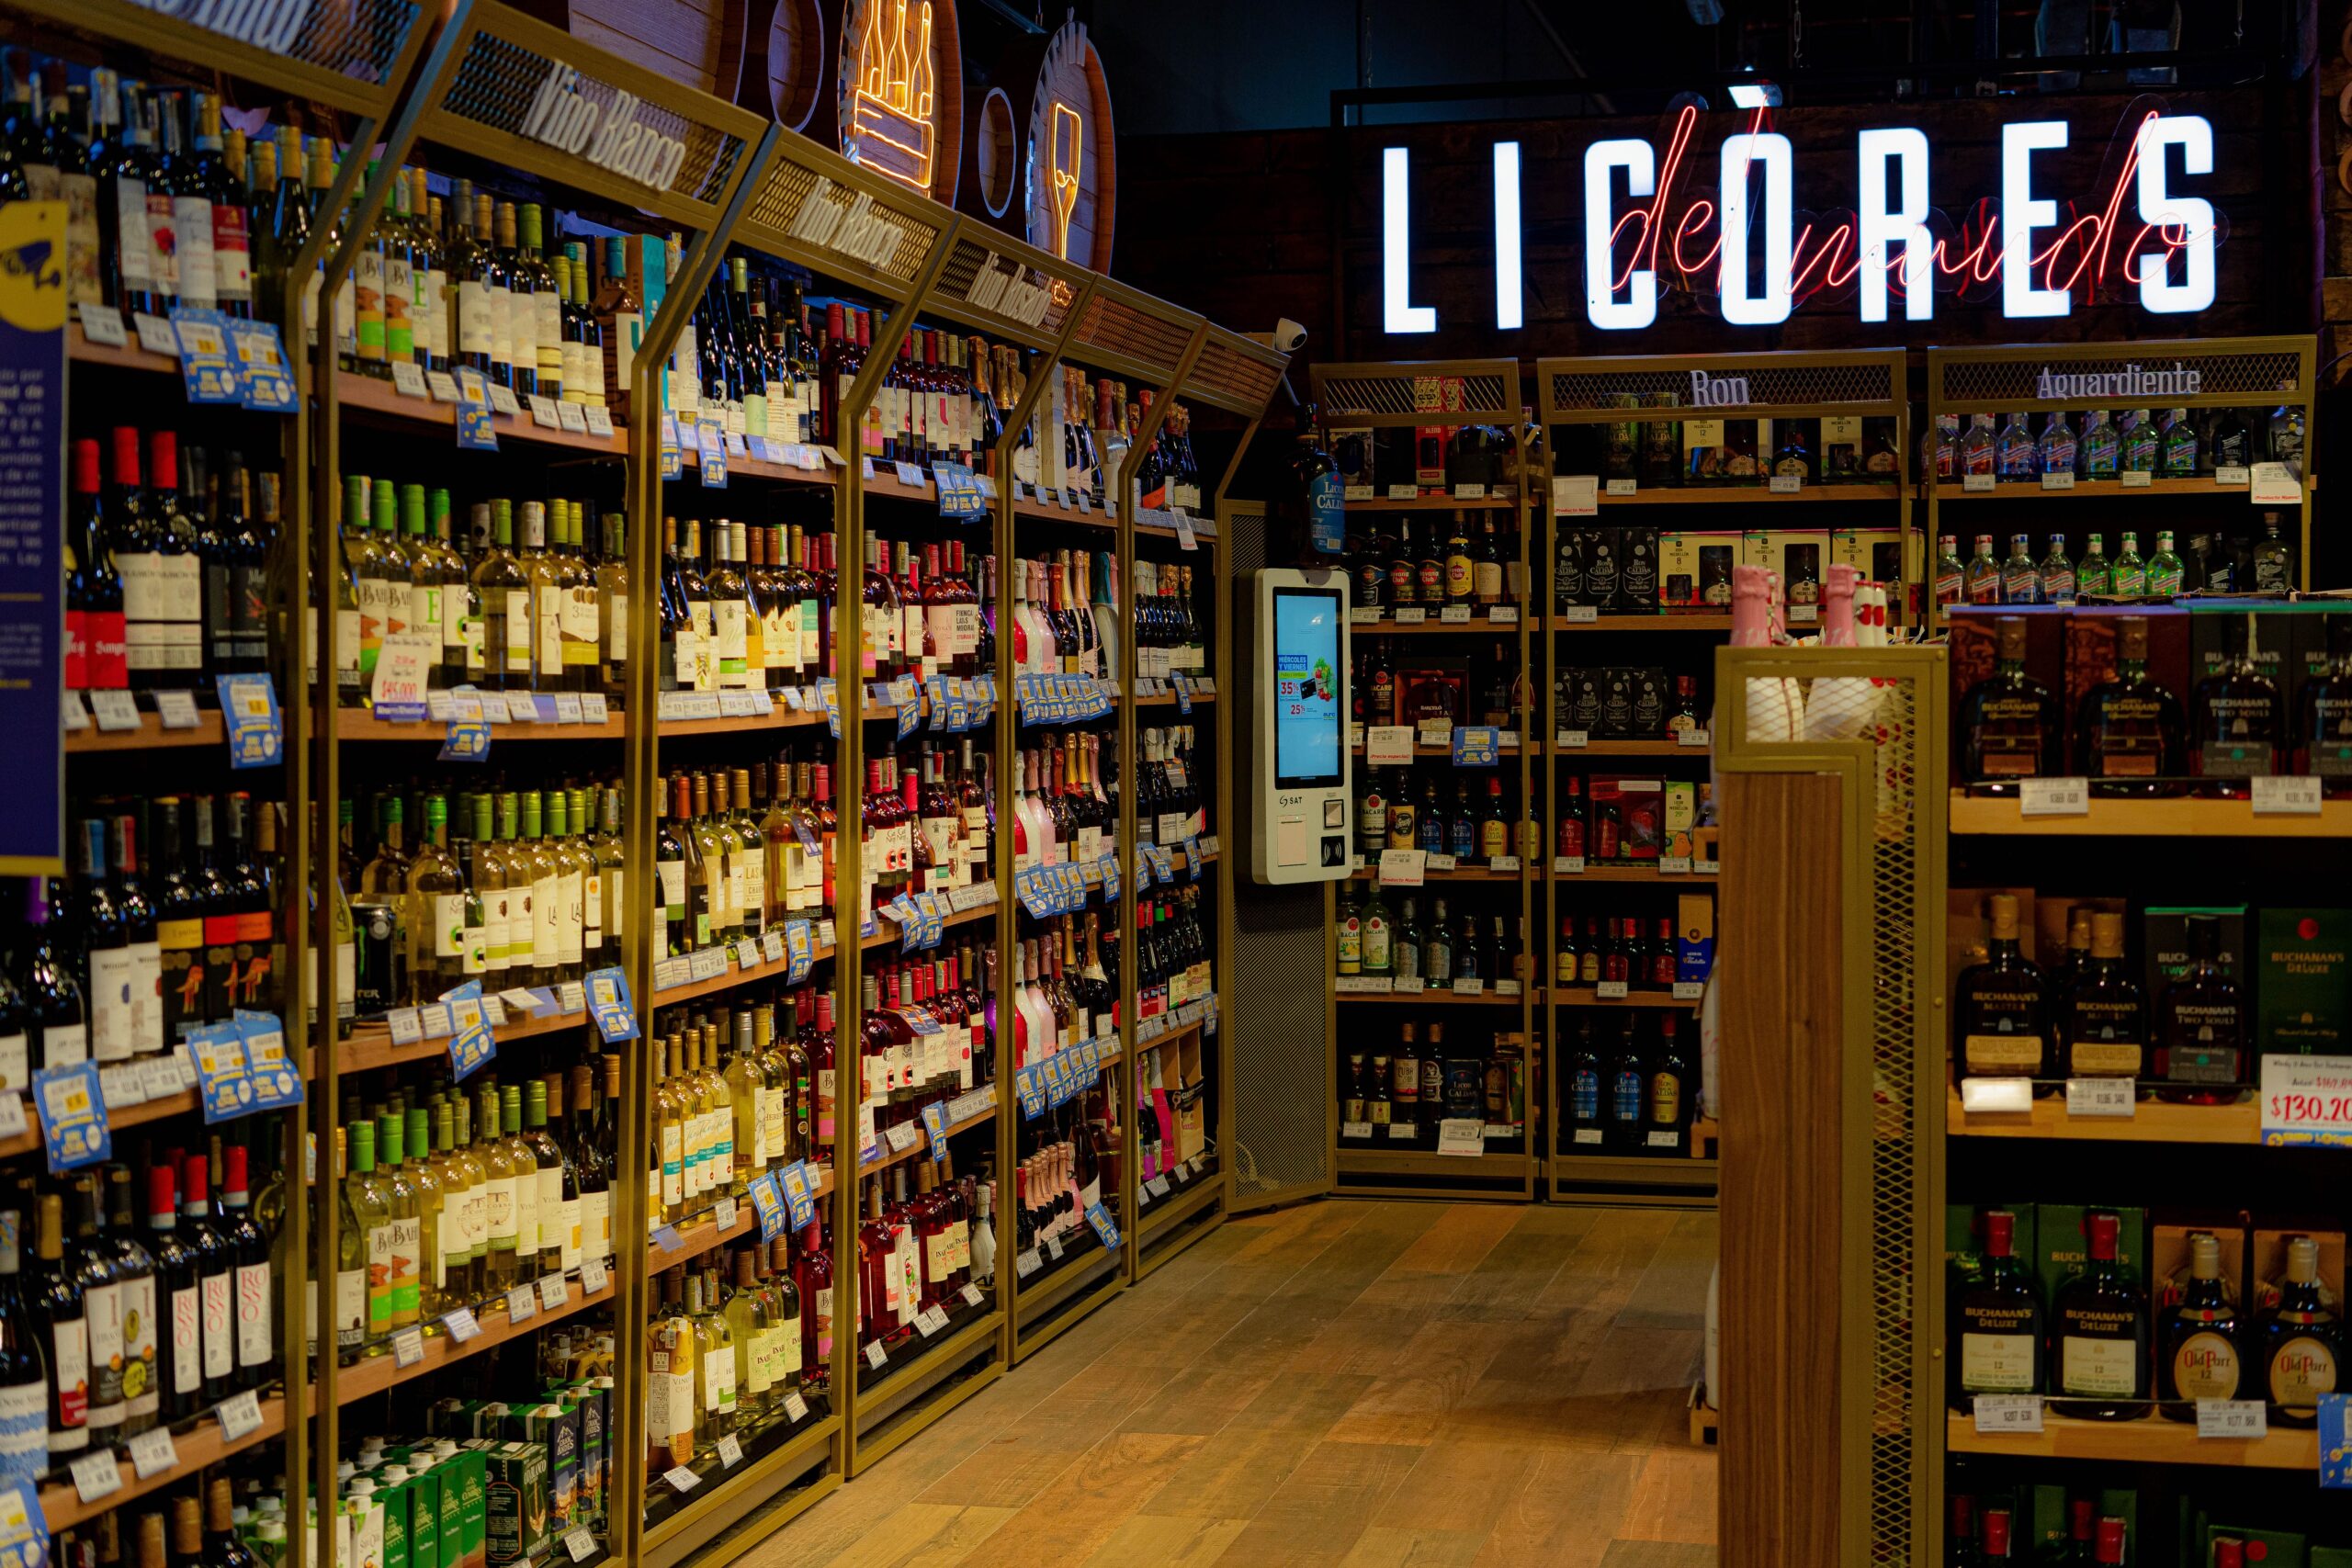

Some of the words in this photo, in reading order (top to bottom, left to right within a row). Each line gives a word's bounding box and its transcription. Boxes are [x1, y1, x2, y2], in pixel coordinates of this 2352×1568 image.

[520, 59, 599, 154] Vino
[587, 89, 686, 191] Blanco
[787, 175, 843, 246] Vino
[831, 190, 903, 265] Blanco
[1383, 115, 2217, 333] LICORES
[965, 250, 1009, 310] Vino
[2037, 363, 2201, 400] Aguardiente
[1690, 370, 1749, 407] Ron
[1324, 481, 1344, 494] LICO
[1317, 494, 1345, 509] CALD
[1677, 557, 1681, 565] 8
[2205, 650, 2281, 663] BUAN'S
[1281, 682, 1299, 695] 35%
[1982, 701, 2041, 712] BUCHANAN'S
[2102, 701, 2162, 713] BUCHANAN'S
[2210, 698, 2271, 708] BUCHANAN'S
[2315, 698, 2352, 708] BUCHA
[2212, 707, 2235, 718] TWO
[1290, 796, 1303, 805] SAT
[2158, 953, 2234, 964] BUCH'S
[2271, 952, 2345, 963] BUCHANAN'S
[2286, 963, 2330, 974] DELUXE
[1973, 991, 2039, 1002] BUCHANAN'S
[2075, 1001, 2138, 1011] BUCHANAN'S
[2176, 1004, 2236, 1015] BUCHANAN'S
[2177, 1015, 2202, 1025] TWO
[2205, 1015, 2234, 1025] SOULS
[1965, 1306, 2033, 1319] BUCHANAN'S
[2066, 1309, 2134, 1323] BUCHANAN'S
[1979, 1318, 2018, 1328] DELUXE
[2079, 1320, 2120, 1332] DELUXE
[2184, 1349, 2204, 1368] Old
[2205, 1350, 2231, 1368] Parr
[2280, 1355, 2301, 1373] Old
[2302, 1356, 2327, 1373] Parr
[1994, 1360, 2003, 1370] 12
[2095, 1365, 2104, 1374] 12
[2200, 1370, 2211, 1379] 12
[2297, 1375, 2308, 1385] 12
